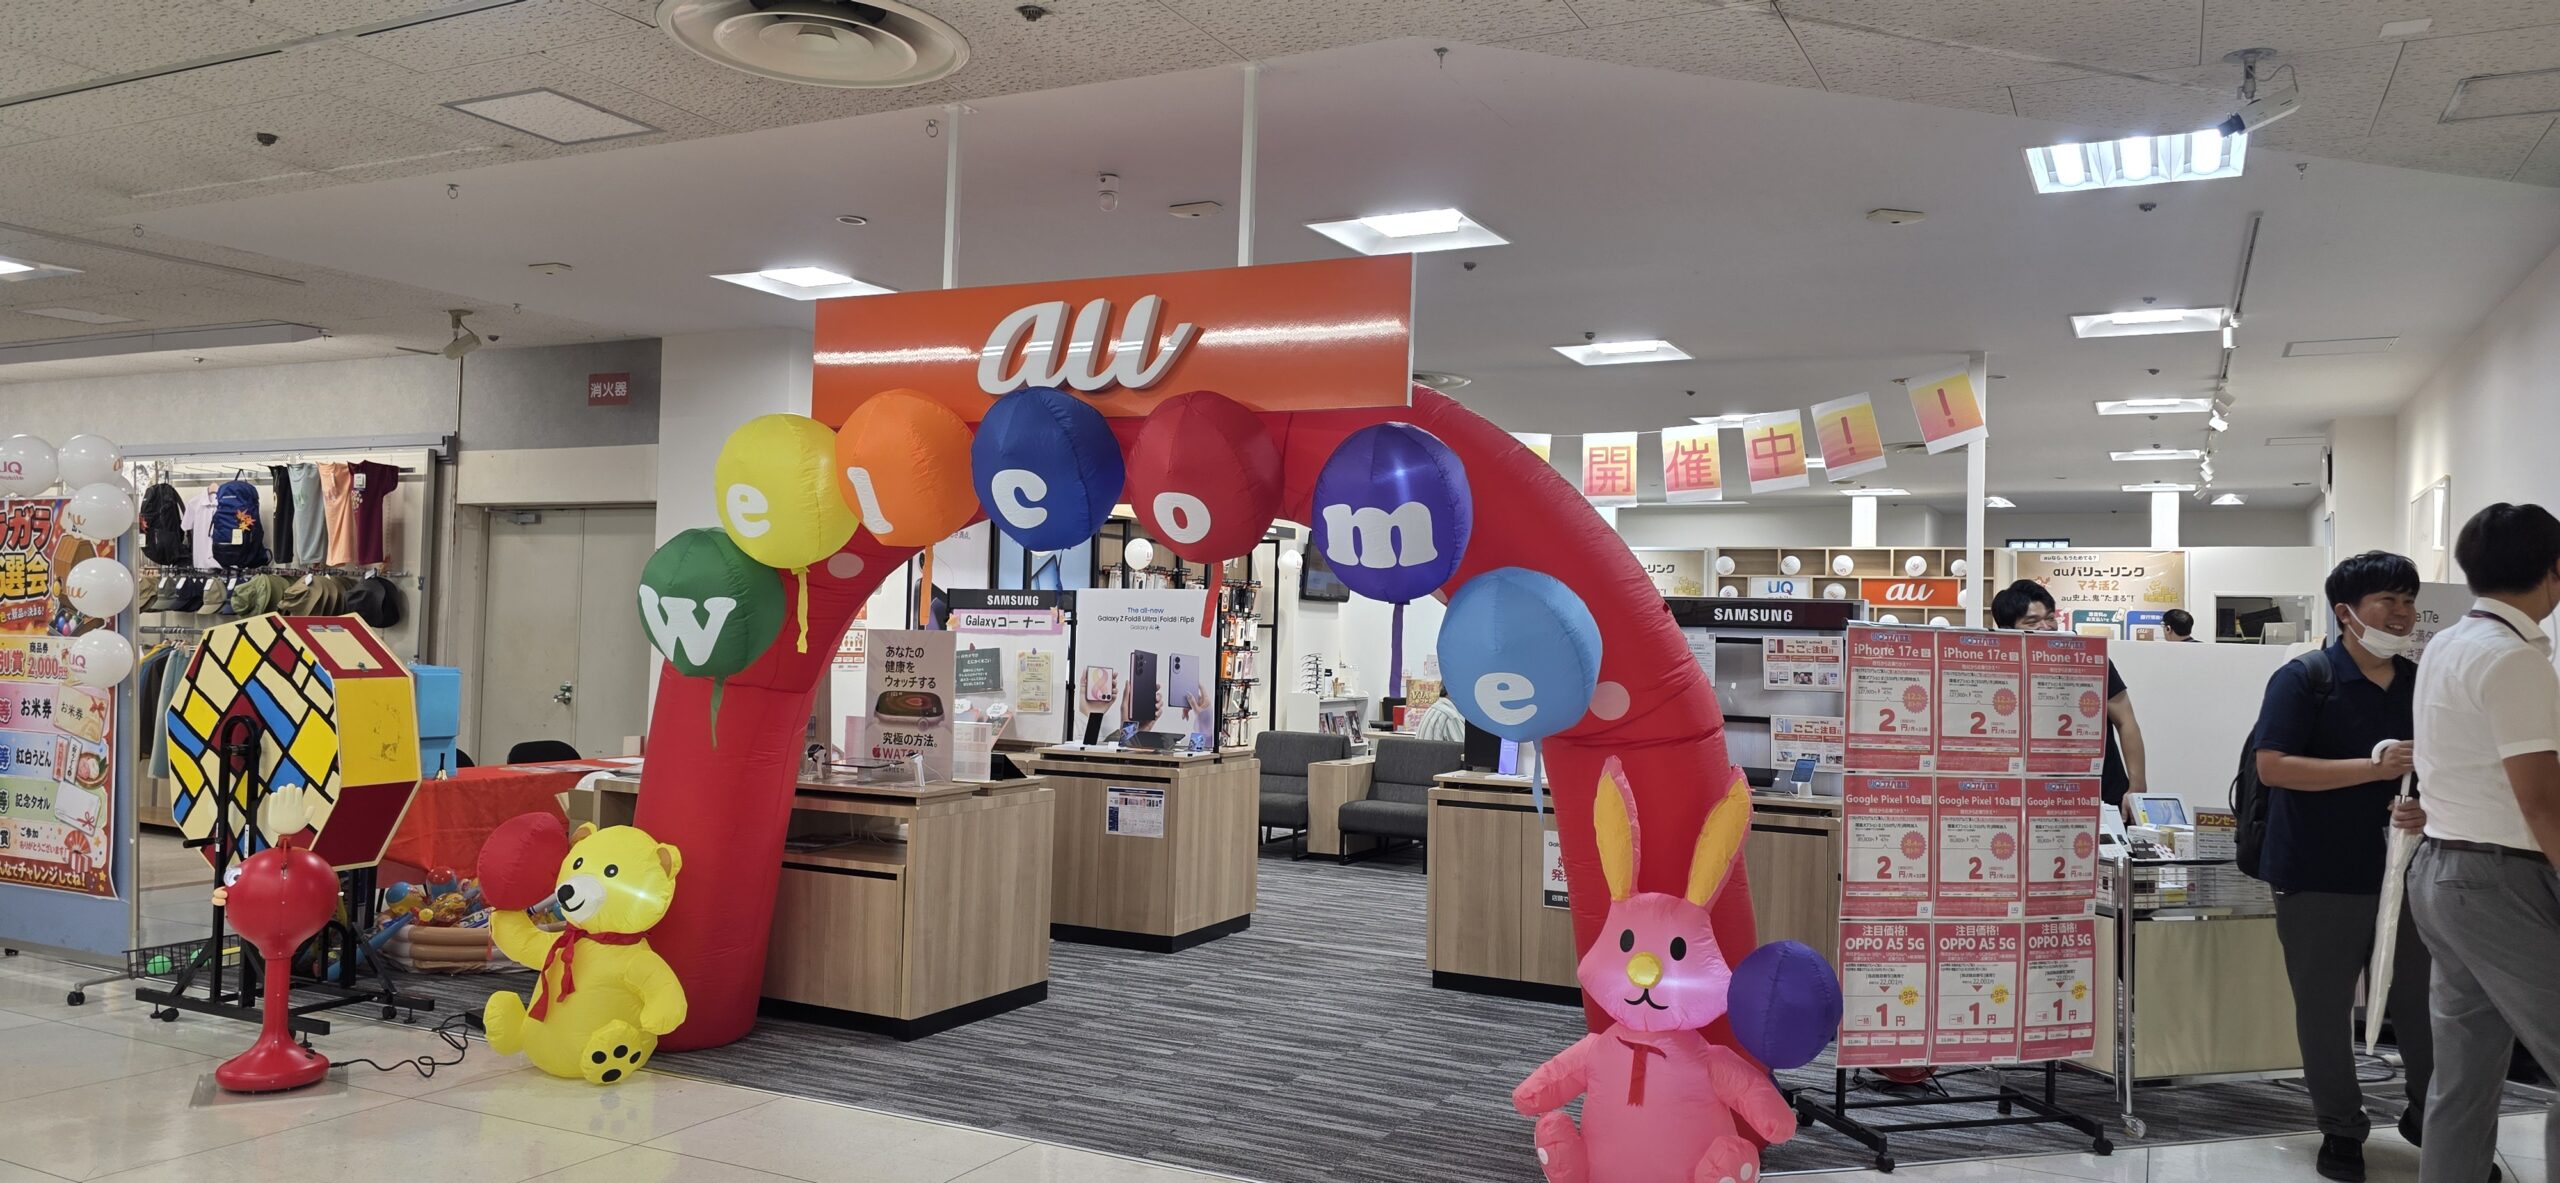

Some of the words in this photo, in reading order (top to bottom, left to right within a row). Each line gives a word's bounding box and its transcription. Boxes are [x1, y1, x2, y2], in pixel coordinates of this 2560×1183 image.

[977, 294, 1199, 395] au
[590, 381, 628, 398] 消火器
[1645, 564, 1675, 574] リング
[2053, 566, 2145, 577] auバリューリング
[1767, 580, 1794, 595] UQ
[1885, 582, 1935, 602] au
[2077, 580, 2120, 591] マネ活2
[987, 594, 1040, 606] SAMSUNG
[1097, 615, 1119, 623] Galaxy
[1180, 616, 1195, 624] Flip8
[1713, 608, 1793, 622] SAMSUNG
[29, 642, 49, 653] 商品券
[884, 646, 925, 659] あなたの
[1854, 643, 1895, 657] iPhone
[1898, 645, 1919, 657] 17e
[1944, 647, 1984, 660] iPhone
[1987, 648, 2008, 661] 17e
[2032, 651, 2071, 663] iPhone
[2074, 652, 2093, 664] 17e
[884, 661, 915, 673] 健康を
[884, 676, 937, 689] ウォッチする
[20, 698, 52, 719] お米券
[60, 702, 84, 721] お米券
[1879, 708, 1897, 732] 2
[1970, 712, 1987, 734] 2
[2057, 714, 2073, 736] 2
[882, 732, 938, 748] 究極の方法。
[16, 748, 52, 767] 紅白うどん
[883, 748, 924, 760] WAT
[15, 793, 51, 810] 記念タオル
[1846, 794, 1876, 806] Google
[1881, 795, 1902, 804] Pixel
[1905, 796, 1921, 804] 10a
[1939, 795, 1969, 807] Google
[1971, 796, 1992, 805] Pixel
[1994, 797, 2010, 806] 10a
[2027, 797, 2054, 808] Google
[2056, 797, 2075, 806] Pixel
[2077, 797, 2091, 806] 10a
[20, 827, 39, 838] ご参加
[1877, 856, 1892, 879] 2
[1969, 856, 1983, 880] 2
[2053, 856, 2066, 879] 2
[1862, 925, 1908, 937] 注目価格!
[1956, 925, 2000, 937] 注目価格!
[2041, 924, 2078, 935] 注目価格!
[1845, 937, 1883, 950] OPPO
[1886, 937, 1904, 950] A5
[1907, 938, 1925, 950] 5G
[1939, 937, 1976, 950] OPPO
[1979, 937, 1996, 950] A5
[1999, 937, 2016, 950] 5G
[2028, 936, 2059, 949] OPPO
[2061, 935, 2075, 946] A5
[2077, 934, 2092, 946] 5G
[1876, 1003, 1887, 1026] 1
[1895, 1015, 1906, 1026] 円
[1968, 1002, 1980, 1025] 1
[1987, 1014, 1997, 1024] 円
[2053, 998, 2063, 1021] 1
[2068, 1009, 2077, 1020] 円
